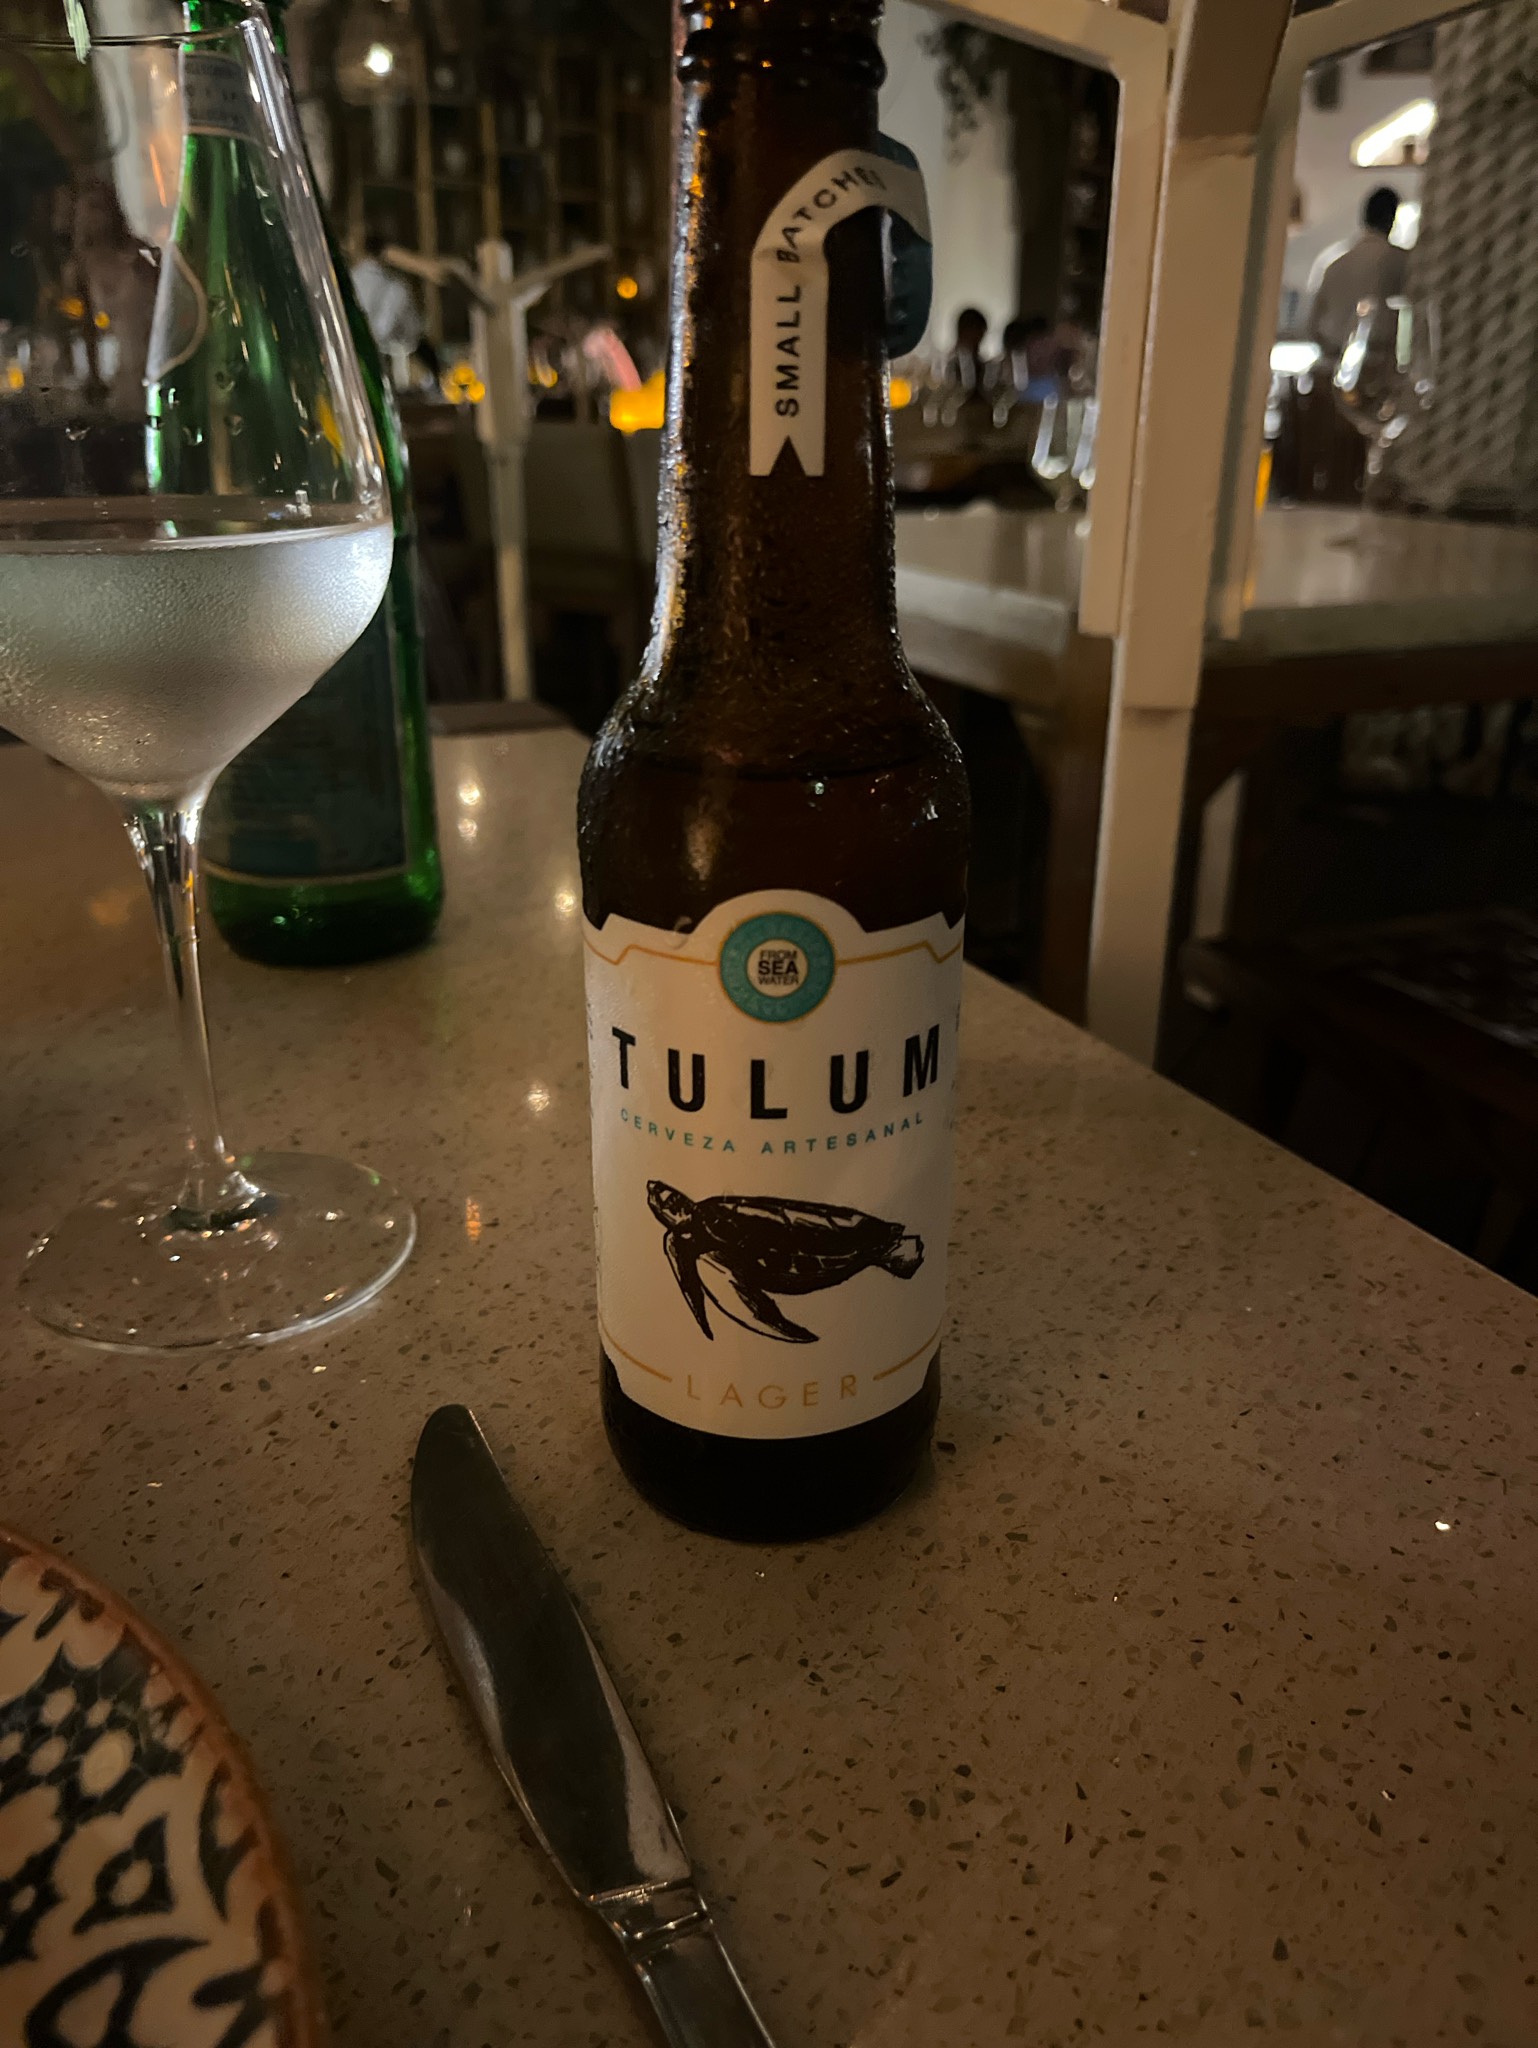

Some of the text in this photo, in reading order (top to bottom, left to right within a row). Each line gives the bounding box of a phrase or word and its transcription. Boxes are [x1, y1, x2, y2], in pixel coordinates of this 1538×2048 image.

[776, 284, 801, 417] SMALL
[758, 960, 798, 975] SEA
[759, 949, 798, 960] FROM
[758, 975, 799, 986] WATER
[611, 1023, 940, 1119] TULUM
[620, 1107, 923, 1155] CERVEZA ARTESANAL
[686, 1373, 858, 1410] LAGER
